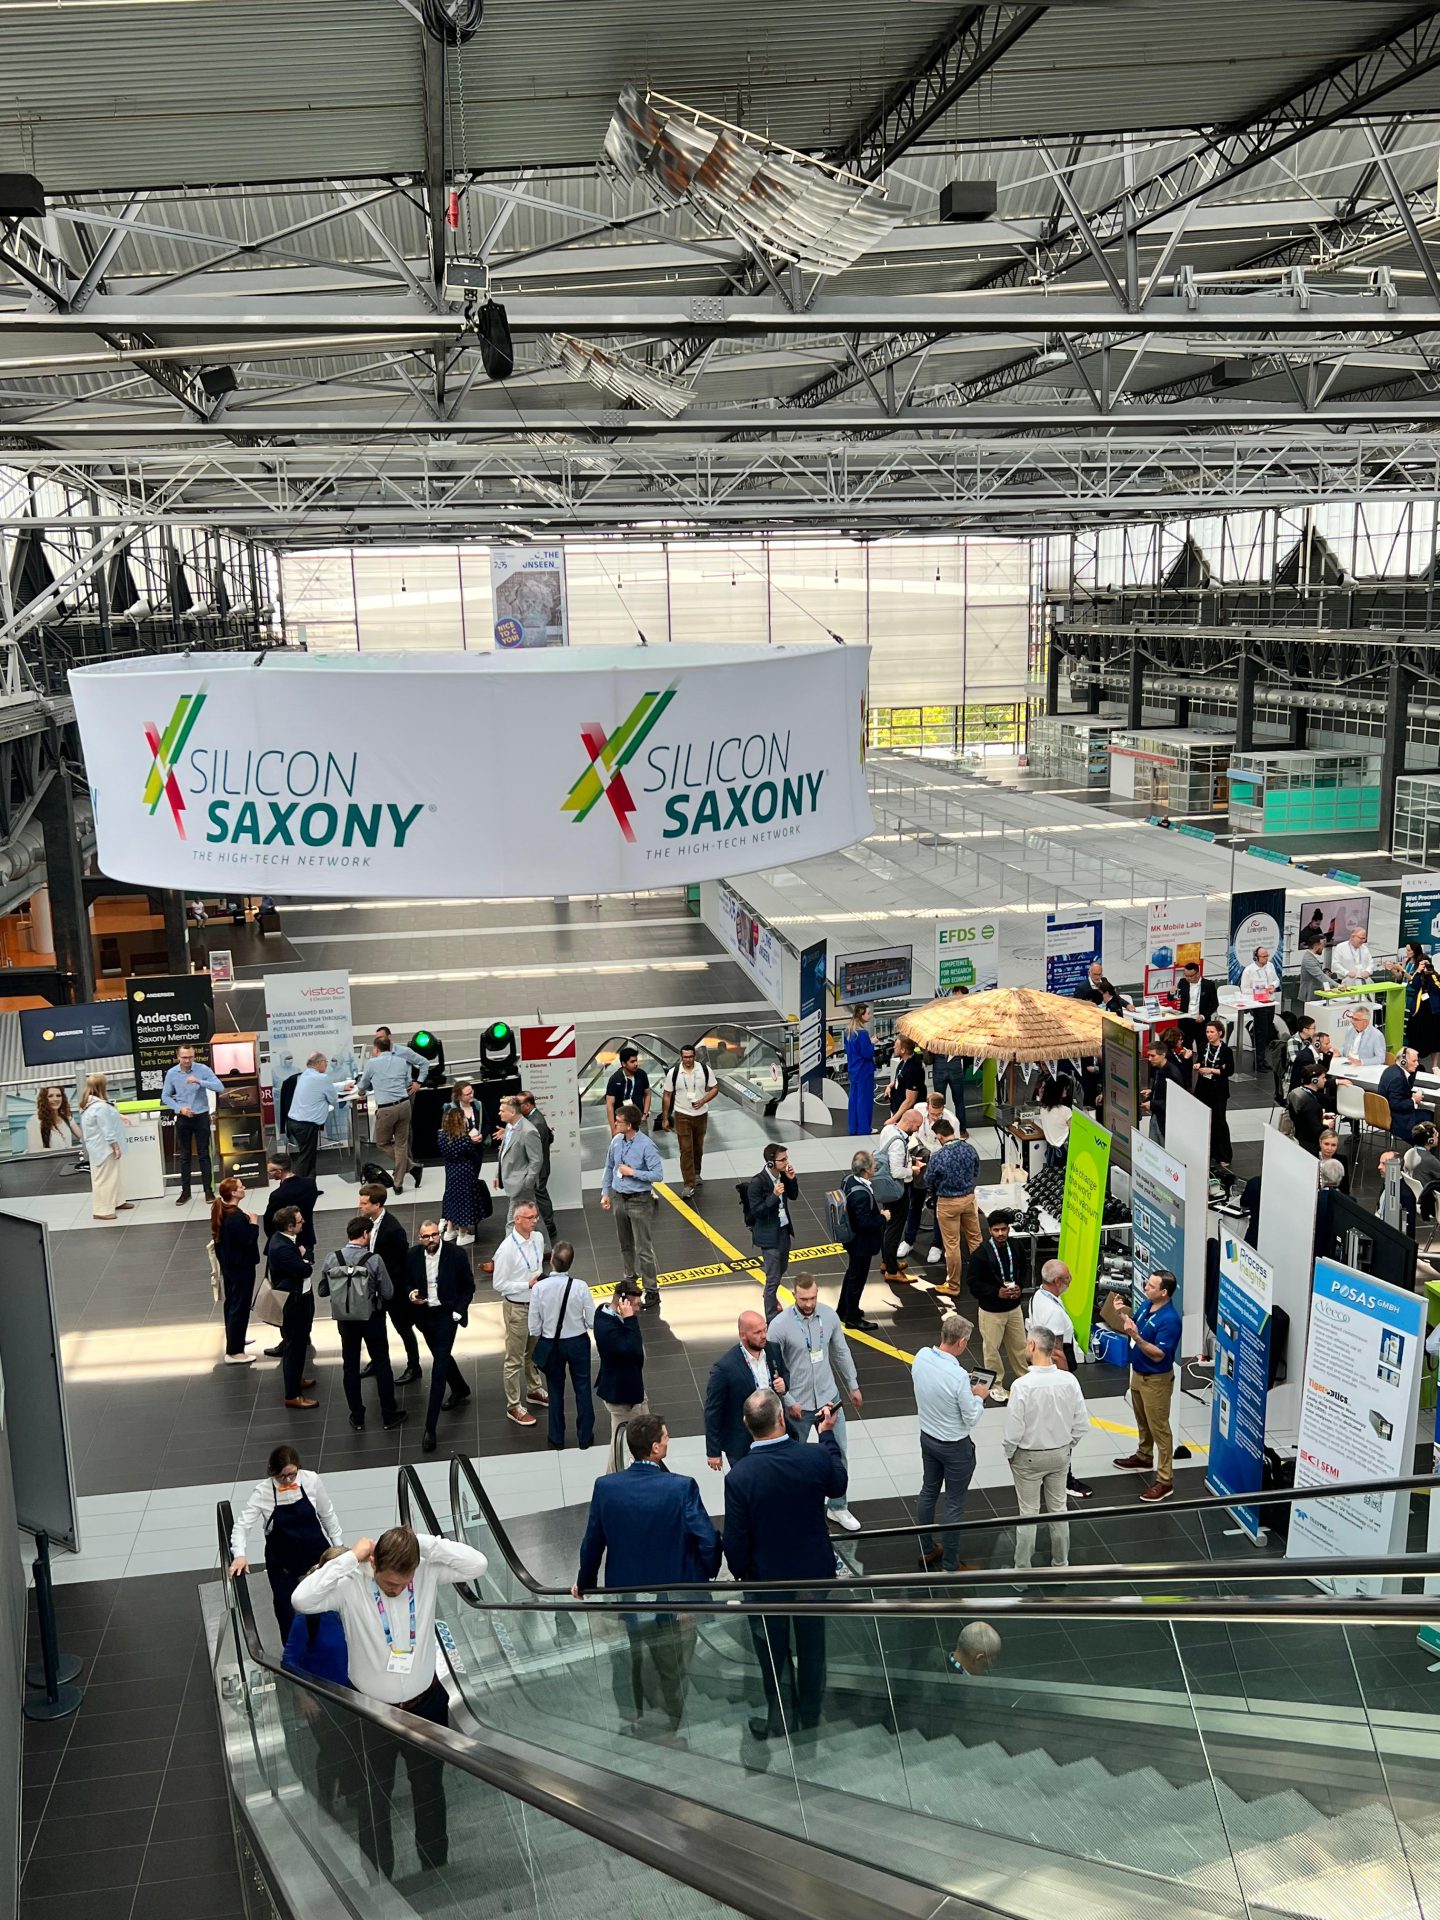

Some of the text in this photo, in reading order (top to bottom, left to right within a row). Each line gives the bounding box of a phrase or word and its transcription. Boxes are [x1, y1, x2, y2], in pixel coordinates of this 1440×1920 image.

[498, 621, 514, 631] NICE
[643, 730, 790, 792] SILICON
[190, 749, 357, 797] SILICON
[663, 770, 824, 838] SAXONY
[206, 800, 424, 848] SAXONY
[646, 825, 801, 860] THE HIGH-TECH NETWORK
[192, 850, 371, 867] THE HIGH-TECH NETWORK
[1186, 921, 1202, 929] Labs
[940, 927, 976, 943] EFDS
[950, 967, 971, 975] RESEARCH
[301, 986, 345, 997] vistec
[136, 1012, 191, 1024] Andersen
[137, 1025, 164, 1033] Bitkom
[174, 1023, 199, 1031] Silicon
[138, 1033, 200, 1043] Saxony Member
[1078, 1169, 1097, 1191] change
[1077, 1184, 1092, 1200] world
[1066, 1201, 1088, 1225] solutions
[1079, 1199, 1099, 1220] vacuum
[730, 1259, 761, 1270] DRS
[1331, 1281, 1400, 1314] POSAS GMBH
[1321, 1461, 1340, 1478] SEMI
